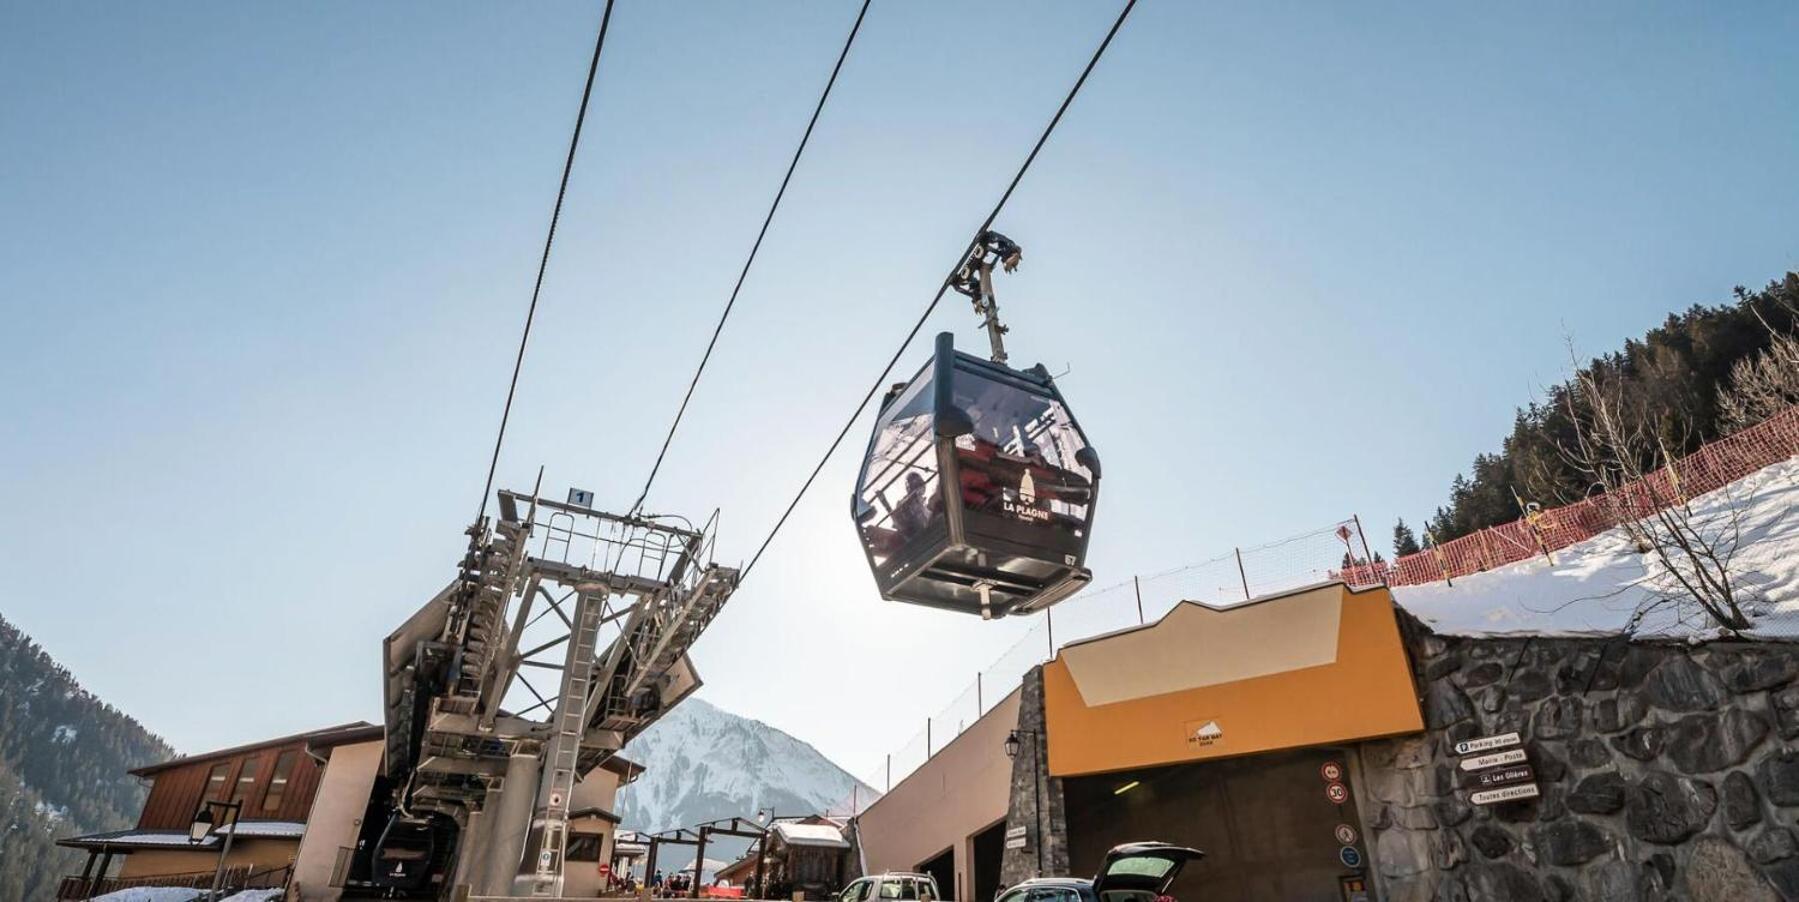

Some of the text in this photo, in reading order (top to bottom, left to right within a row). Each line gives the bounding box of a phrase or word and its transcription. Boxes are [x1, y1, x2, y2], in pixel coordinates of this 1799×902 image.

[576, 492, 584, 502] 1
[1004, 502, 1014, 512] LA
[1016, 504, 1049, 520] PLAGNE
[1471, 740, 1493, 749] Parking
[1504, 753, 1523, 761] Poste
[1492, 773, 1504, 781] Les
[1332, 788, 1342, 797] 30
[1479, 788, 1535, 802] Toutes directions
